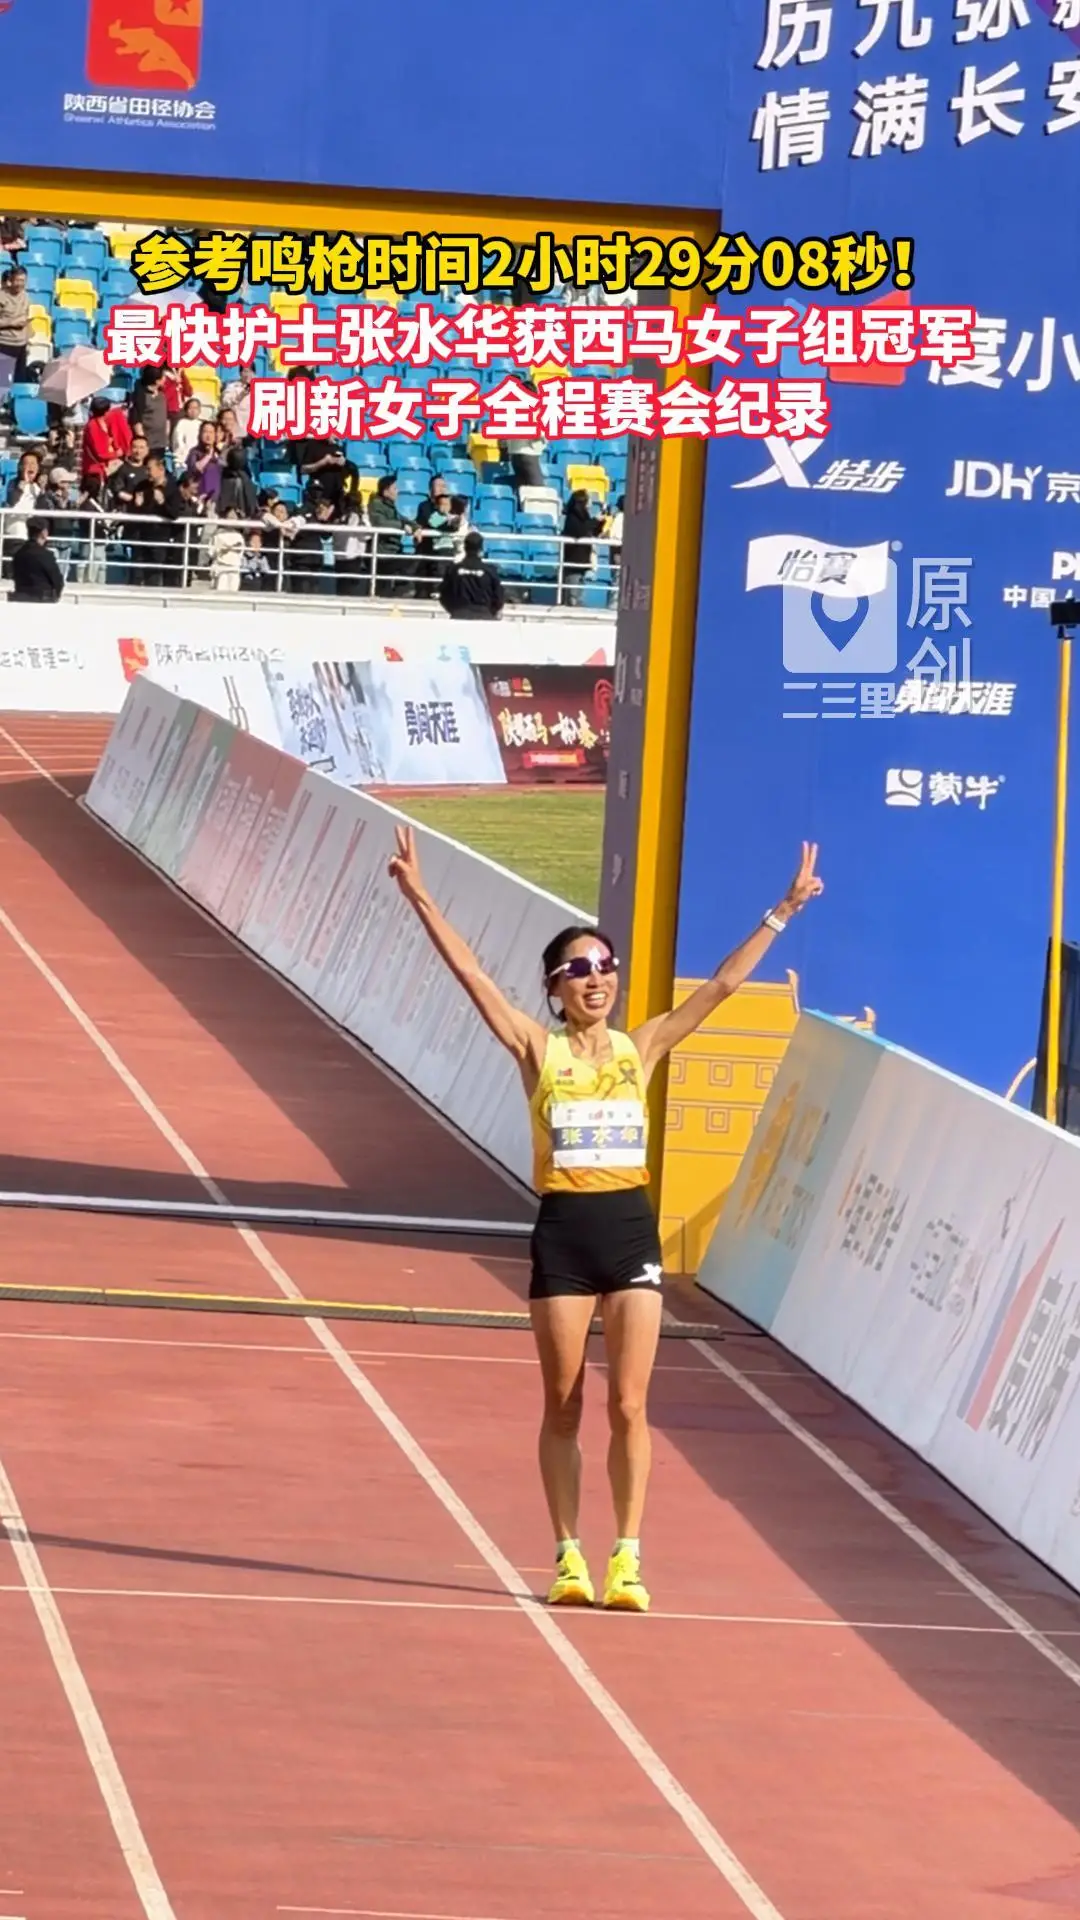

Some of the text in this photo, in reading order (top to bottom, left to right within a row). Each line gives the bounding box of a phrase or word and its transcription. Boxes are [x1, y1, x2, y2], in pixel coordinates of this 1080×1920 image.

[63, 93, 216, 120] 陕西省田径协会
[812, 458, 906, 494] 特步
[1003, 585, 1080, 609] 中国
[929, 771, 999, 810] 蒙牛
